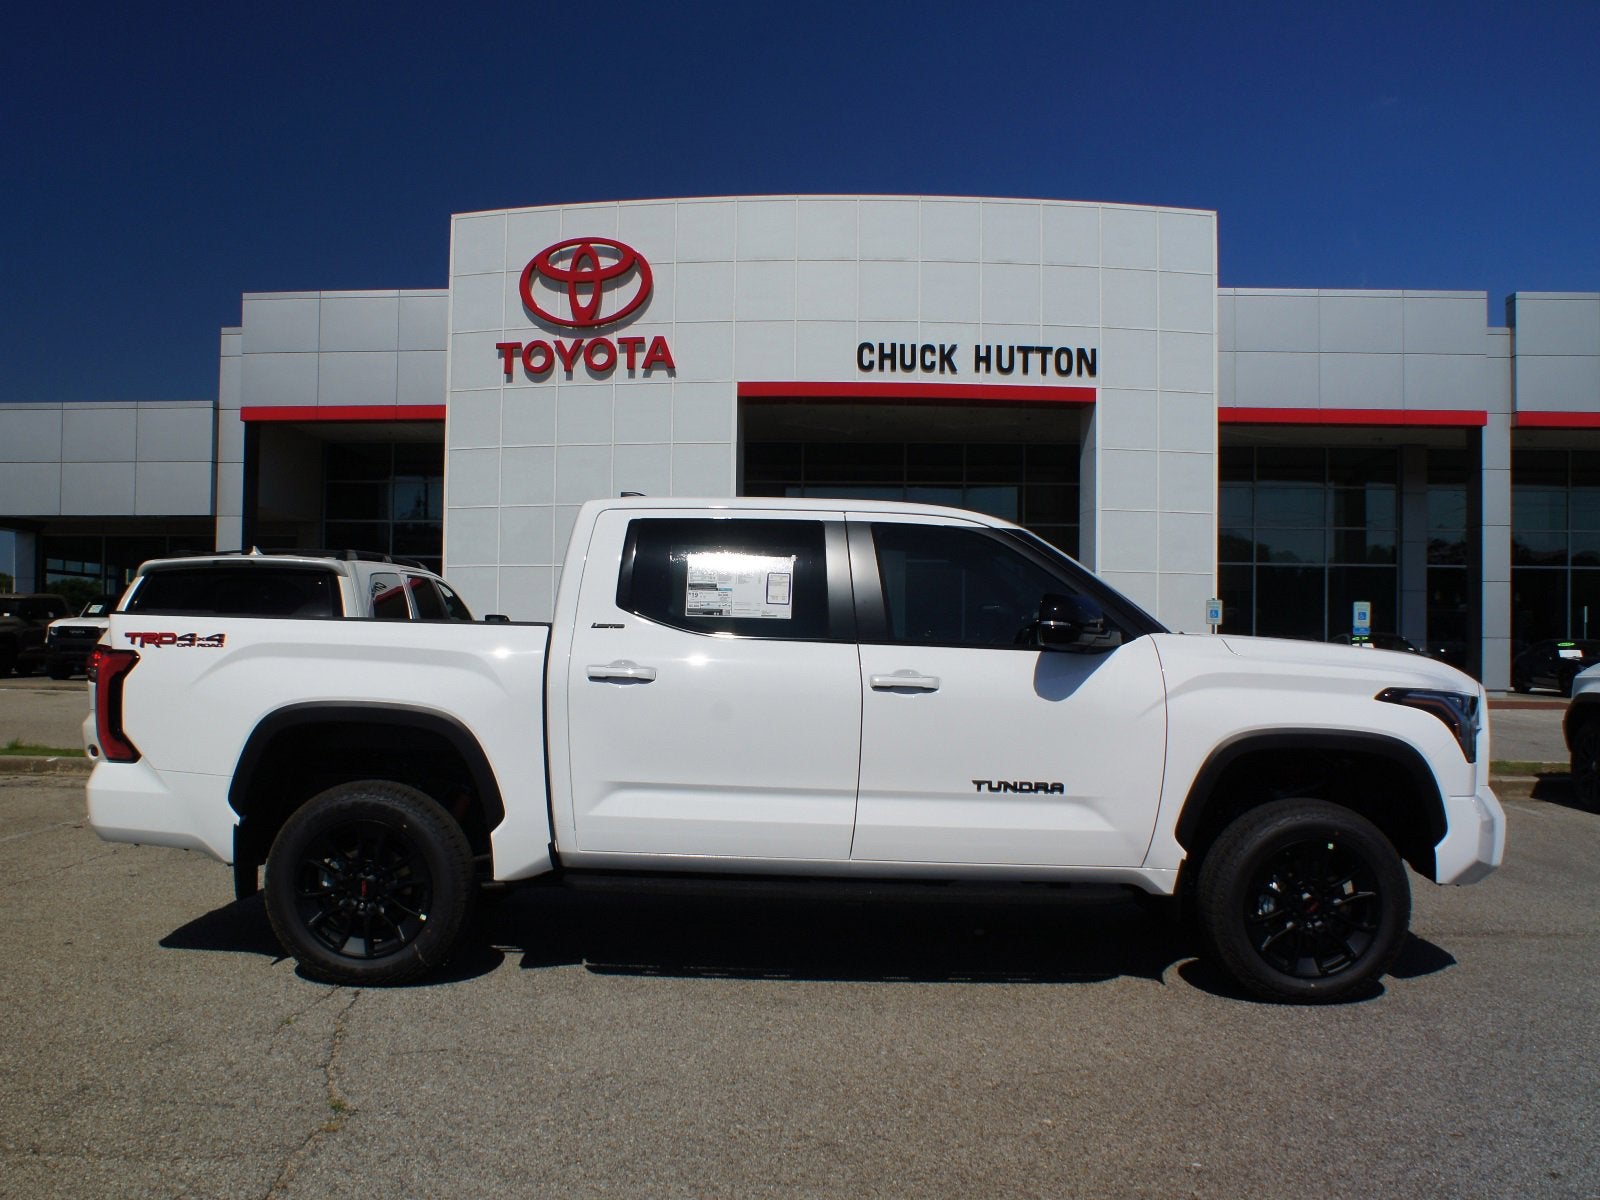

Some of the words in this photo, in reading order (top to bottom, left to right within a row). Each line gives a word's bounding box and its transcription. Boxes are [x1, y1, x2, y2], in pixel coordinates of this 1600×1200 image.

[496, 336, 675, 374] TOYOTA
[857, 342, 957, 374] CHUCK
[974, 344, 1096, 376] HUTTON
[971, 779, 1065, 794] TUNDRA
